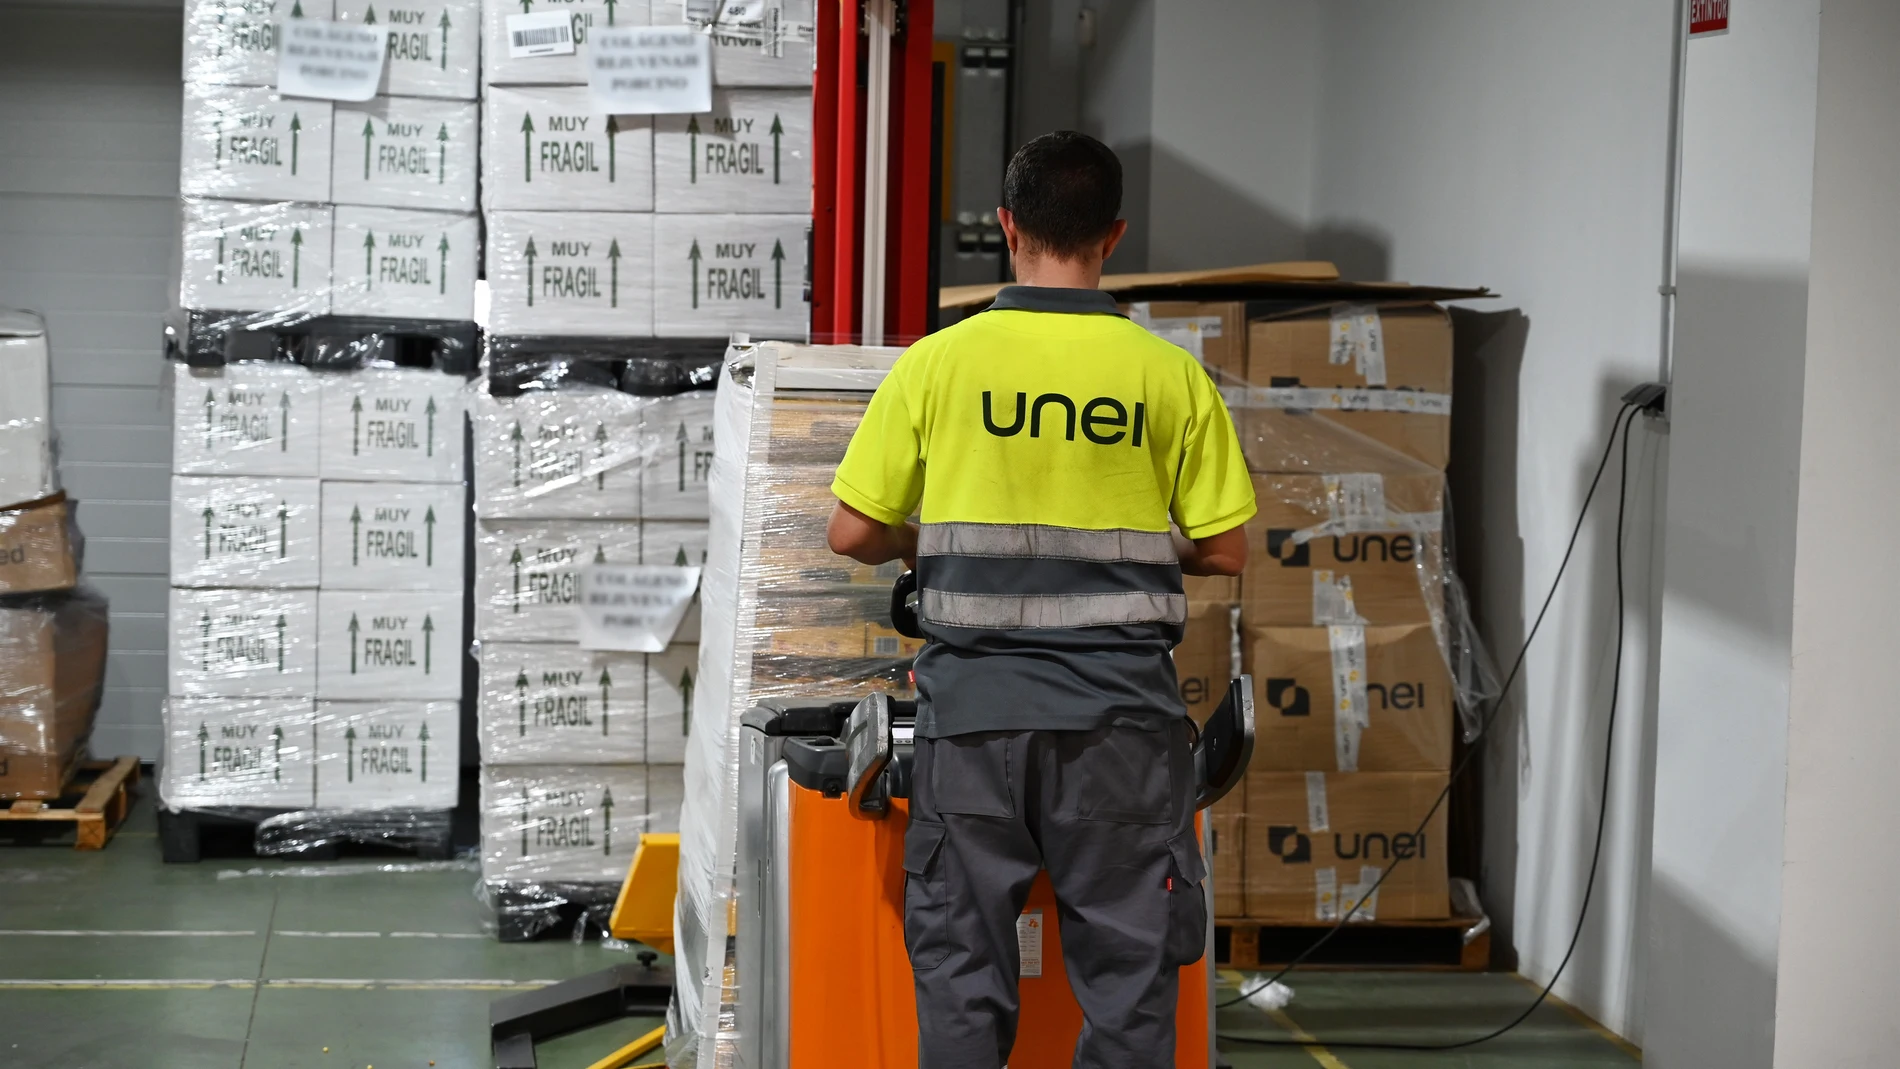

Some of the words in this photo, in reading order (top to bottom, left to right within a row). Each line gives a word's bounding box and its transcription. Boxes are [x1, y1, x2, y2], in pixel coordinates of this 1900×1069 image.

[388, 10, 424, 24] MUY
[387, 32, 432, 60] RAGIL
[387, 123, 424, 137] MUY
[549, 116, 589, 131] MUY
[714, 118, 754, 133] MUY
[230, 136, 282, 166] FRAGIL
[379, 145, 430, 174] FRAGIL
[541, 142, 599, 172] FRAGIL
[706, 144, 764, 174] FRAGIL
[389, 234, 424, 248] MUY
[551, 242, 591, 257] MUY
[716, 244, 756, 259] MUY
[232, 249, 284, 279] FRAGIL
[380, 257, 431, 285] FRAGIL
[543, 267, 601, 297] FRAGIL
[708, 268, 765, 299] FRAGIL
[229, 391, 265, 406] MUY
[376, 398, 411, 412] MUY
[221, 414, 272, 441] FRAGIL
[368, 421, 418, 448] FRAGIL
[375, 508, 410, 522] MUY
[367, 530, 418, 558] FRAGIL
[537, 548, 577, 564] MUY
[1333, 534, 1416, 563] une
[372, 617, 408, 631] MUY
[365, 639, 416, 666] FRAGIL
[543, 672, 583, 686] MUY
[535, 696, 593, 726] FRAGIL
[221, 725, 258, 739] MUY
[369, 725, 405, 739] MUY
[362, 747, 412, 774] FRAGIL
[537, 817, 595, 847] FRAGIL
